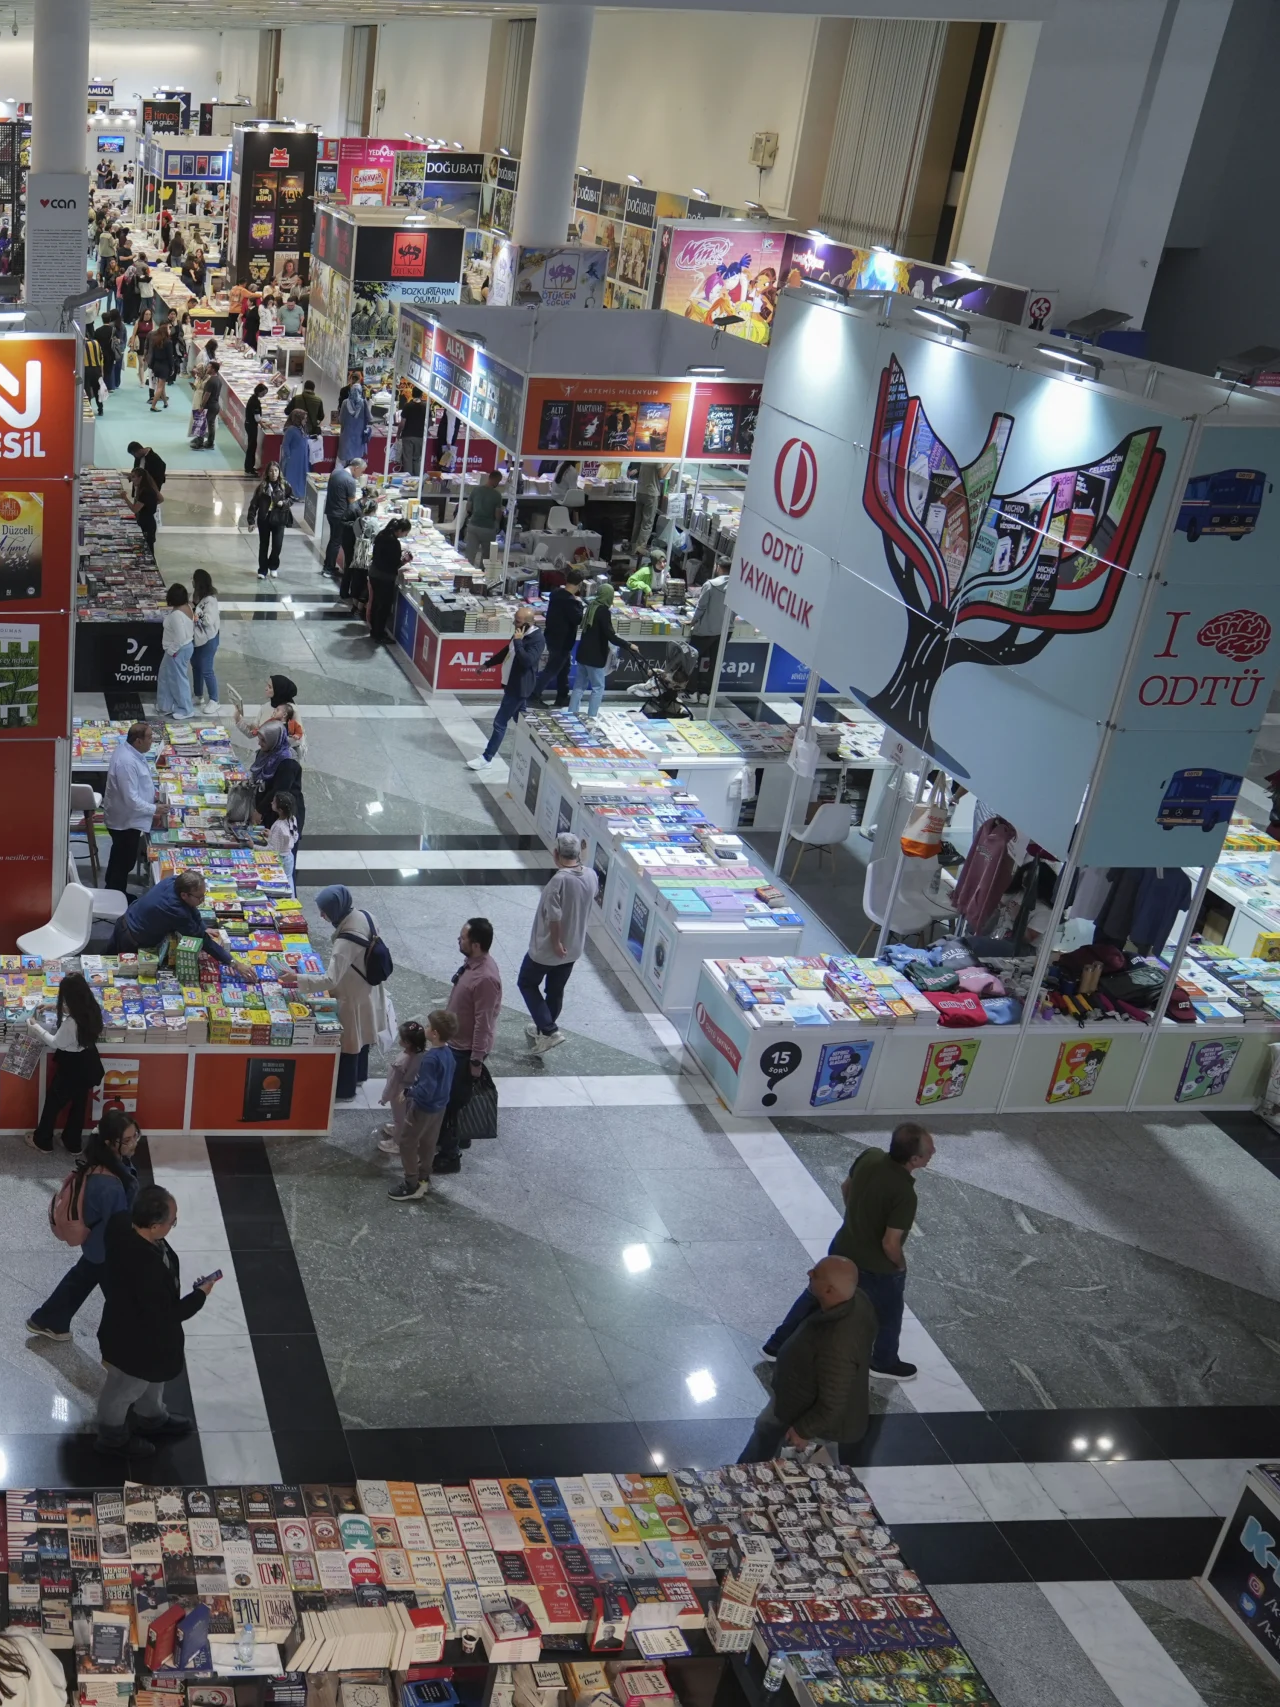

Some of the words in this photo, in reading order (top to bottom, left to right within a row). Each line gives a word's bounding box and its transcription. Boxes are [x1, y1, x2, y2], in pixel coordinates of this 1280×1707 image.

[88, 87, 112, 95] AMLICA
[427, 161, 483, 174] DOĞUBATI
[51, 199, 76, 209] can
[542, 290, 576, 300] ÖTÜKEN
[446, 337, 465, 362] ALFA
[1058, 489, 1064, 497] at
[1004, 503, 1025, 514] MICHIO
[2, 525, 33, 536] Düzceli
[761, 532, 804, 574] ODTÜ
[1037, 565, 1056, 575] MICHIO
[740, 557, 814, 629] YAYINCILIK
[1154, 612, 1191, 658] I
[449, 652, 494, 666] ALF
[121, 664, 152, 673] Doğan
[115, 673, 157, 683] Yayınları
[1138, 669, 1265, 706] ODTÜ
[705, 1023, 716, 1039] ODTÜ
[771, 1051, 791, 1064] 15
[768, 1066, 788, 1074] SORU
